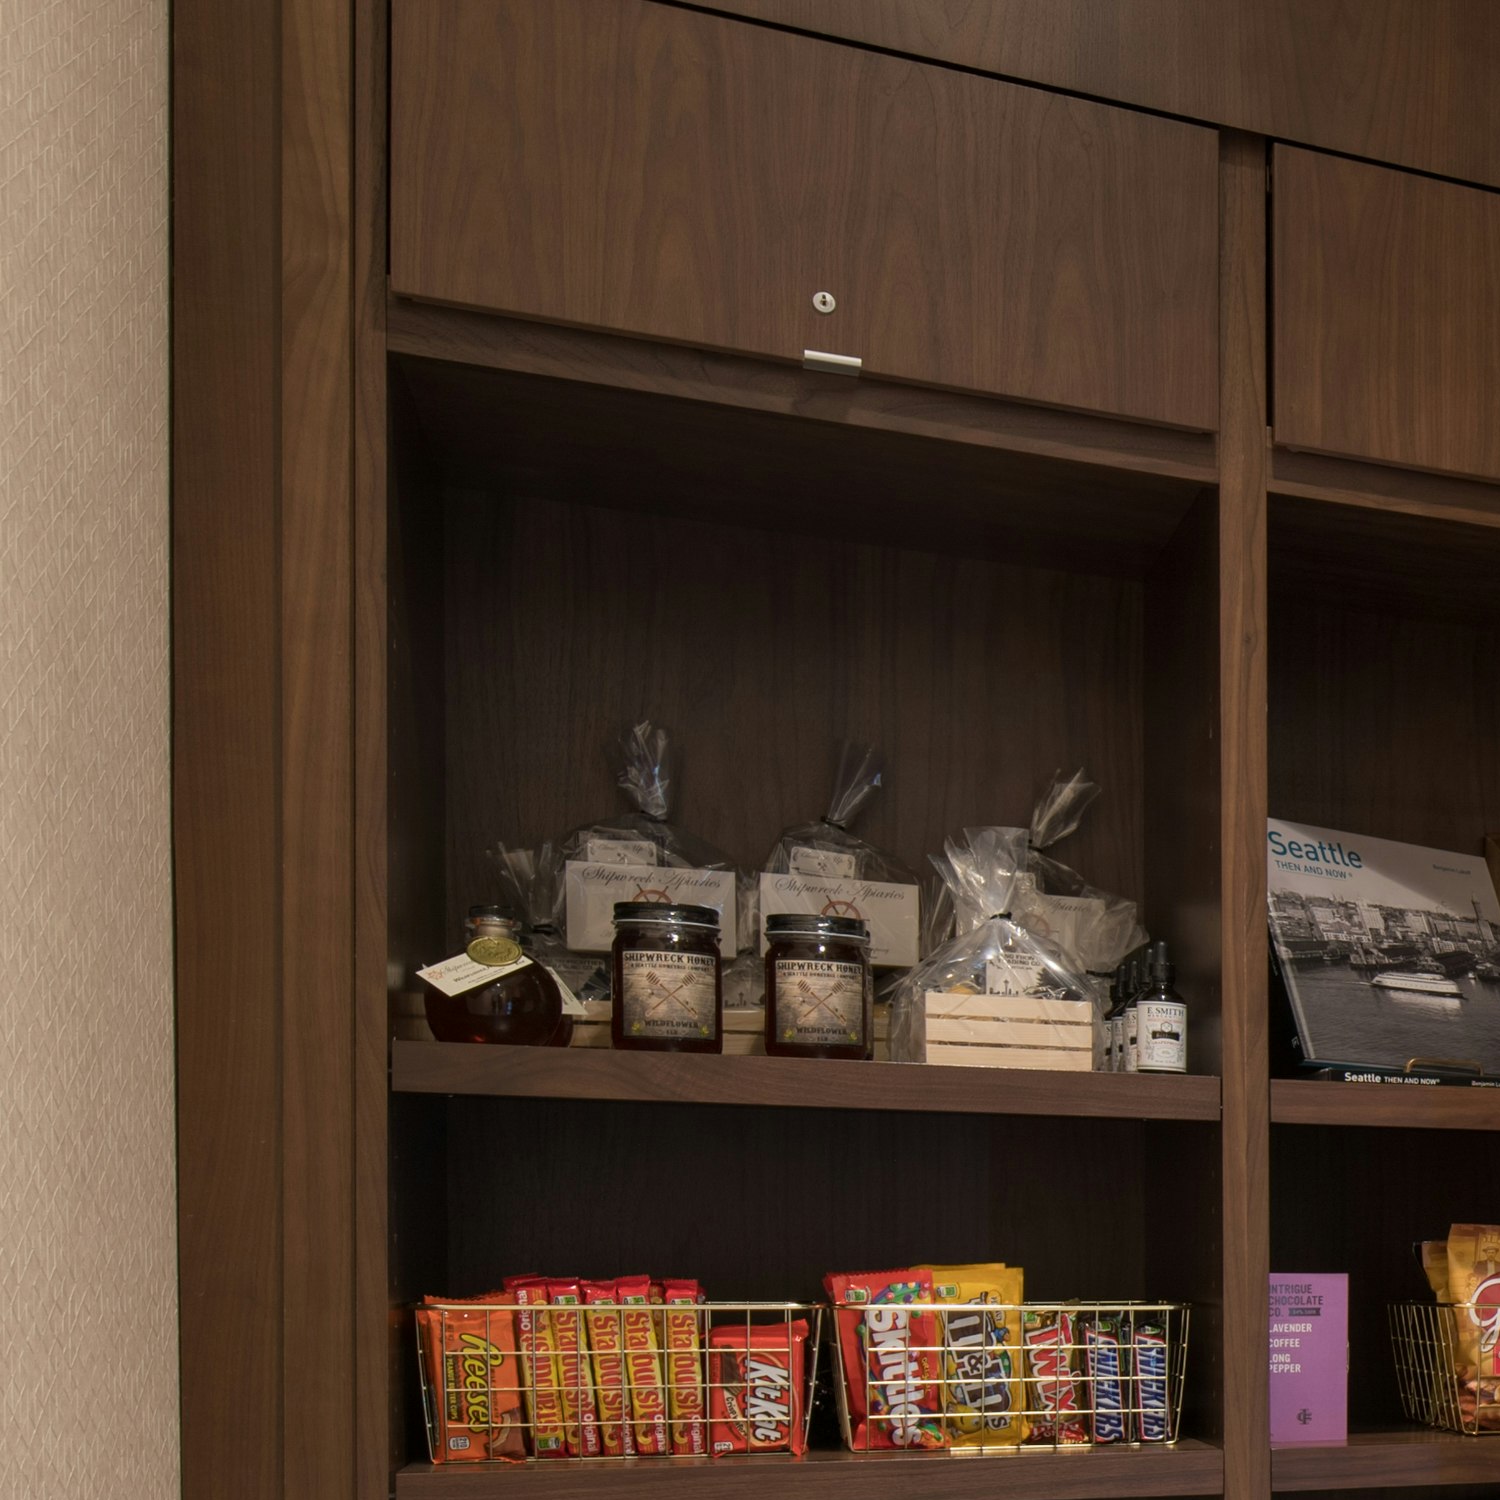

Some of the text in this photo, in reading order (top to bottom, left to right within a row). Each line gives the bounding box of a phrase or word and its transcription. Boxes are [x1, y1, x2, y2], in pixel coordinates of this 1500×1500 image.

[1267, 830, 1363, 869] Seattle
[582, 865, 721, 890] Shipwreck Apiaries
[1275, 860, 1301, 872] THEN
[1303, 865, 1323, 876] AND
[775, 878, 905, 901] Shipwreck Apiaries
[624, 952, 715, 967] SHIPWRECK HONEY
[777, 962, 863, 975] SHIPWRECK HONEY
[1154, 1008, 1184, 1017] SMITH
[1344, 1072, 1381, 1084] Seattle
[1384, 1076, 1403, 1084] THEN
[1471, 1080, 1494, 1088] Benjamin
[1269, 1284, 1312, 1294] INTRIGUE
[1269, 1295, 1323, 1306] CHOCOLATE
[517, 1290, 532, 1330] Orignal
[1269, 1323, 1312, 1332] AVENDER
[447, 1358, 458, 1382] PEANUT
[557, 1311, 593, 1409] Starburst
[593, 1315, 630, 1412] Starburst
[625, 1312, 664, 1409] Starburst
[672, 1314, 699, 1409] Starburst
[1269, 1354, 1291, 1363] ONG
[524, 1333, 560, 1434] Starburst
[864, 1303, 925, 1446] Skittles
[1088, 1336, 1123, 1439] SNICKERS
[1137, 1338, 1168, 1438] SNICKERS
[450, 1405, 459, 1419] CUPS
